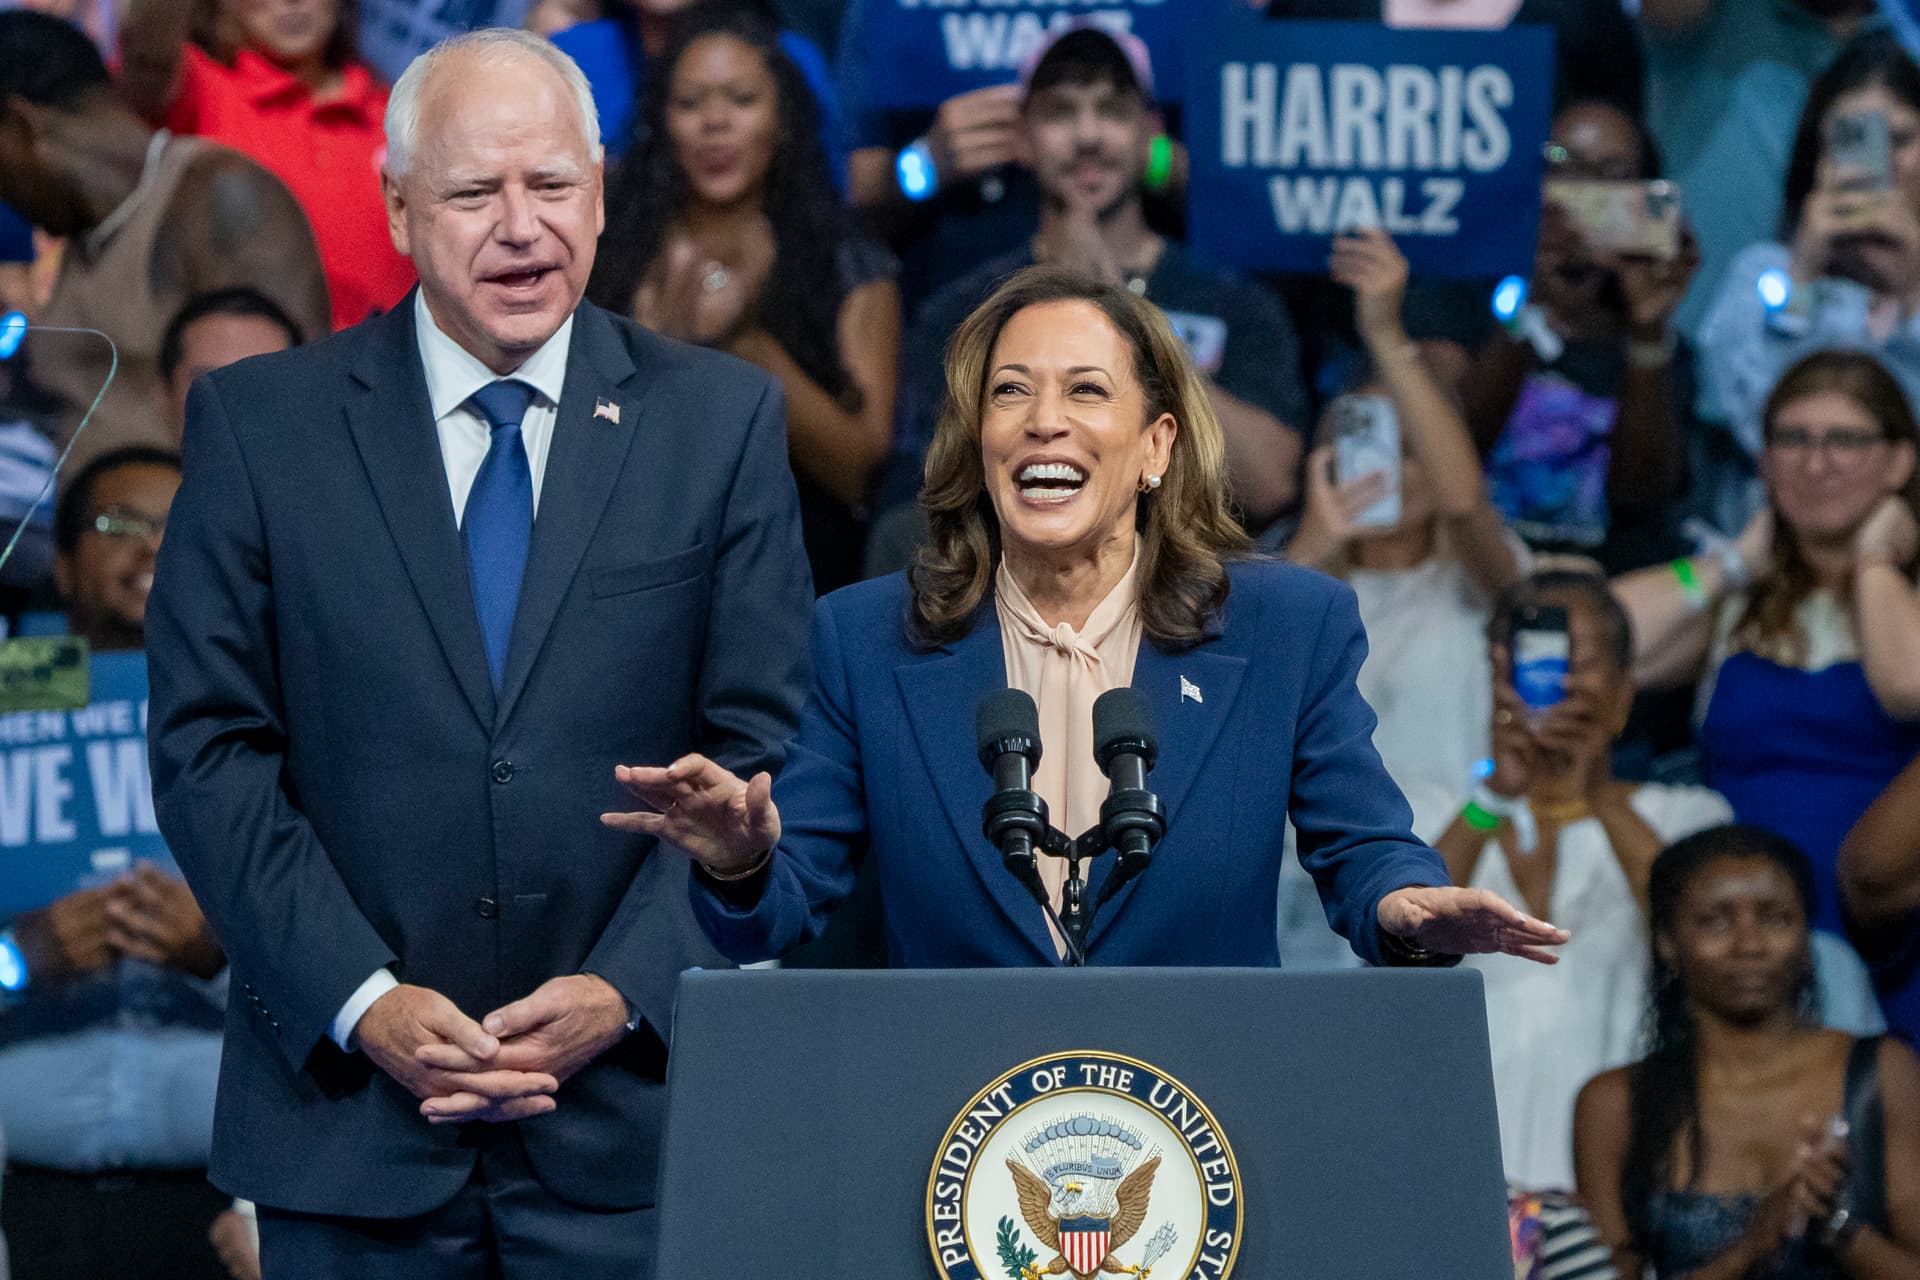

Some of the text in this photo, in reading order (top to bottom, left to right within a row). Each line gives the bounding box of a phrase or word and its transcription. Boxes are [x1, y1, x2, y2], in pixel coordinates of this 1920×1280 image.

[942, 10, 1132, 69] WA
[1221, 62, 1513, 172] HARRIS
[1269, 178, 1464, 235] WALZ
[72, 701, 133, 736] WE
[933, 1083, 1017, 1269] PRESIDENT
[1031, 1066, 1067, 1093] OF
[1080, 1064, 1134, 1092] THE
[1149, 1081, 1235, 1206] UNITED
[1053, 1163, 1093, 1174] PLURIBUS
[1096, 1167, 1122, 1176] UNUM
